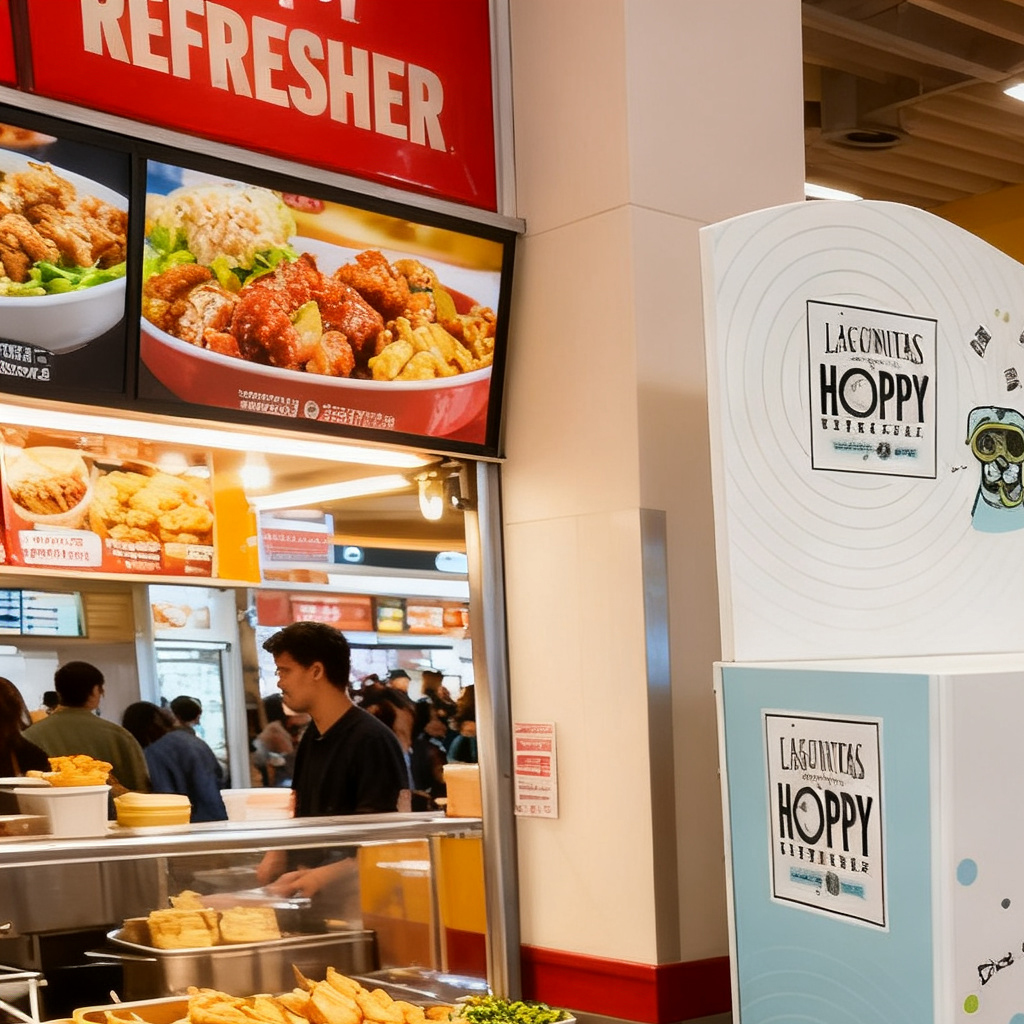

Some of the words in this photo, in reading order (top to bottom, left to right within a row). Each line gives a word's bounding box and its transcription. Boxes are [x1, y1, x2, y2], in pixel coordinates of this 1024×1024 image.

[83, 0, 447, 153] REFRESHER
[820, 363, 929, 423] HOPPY
[777, 782, 873, 857] HOPPY
